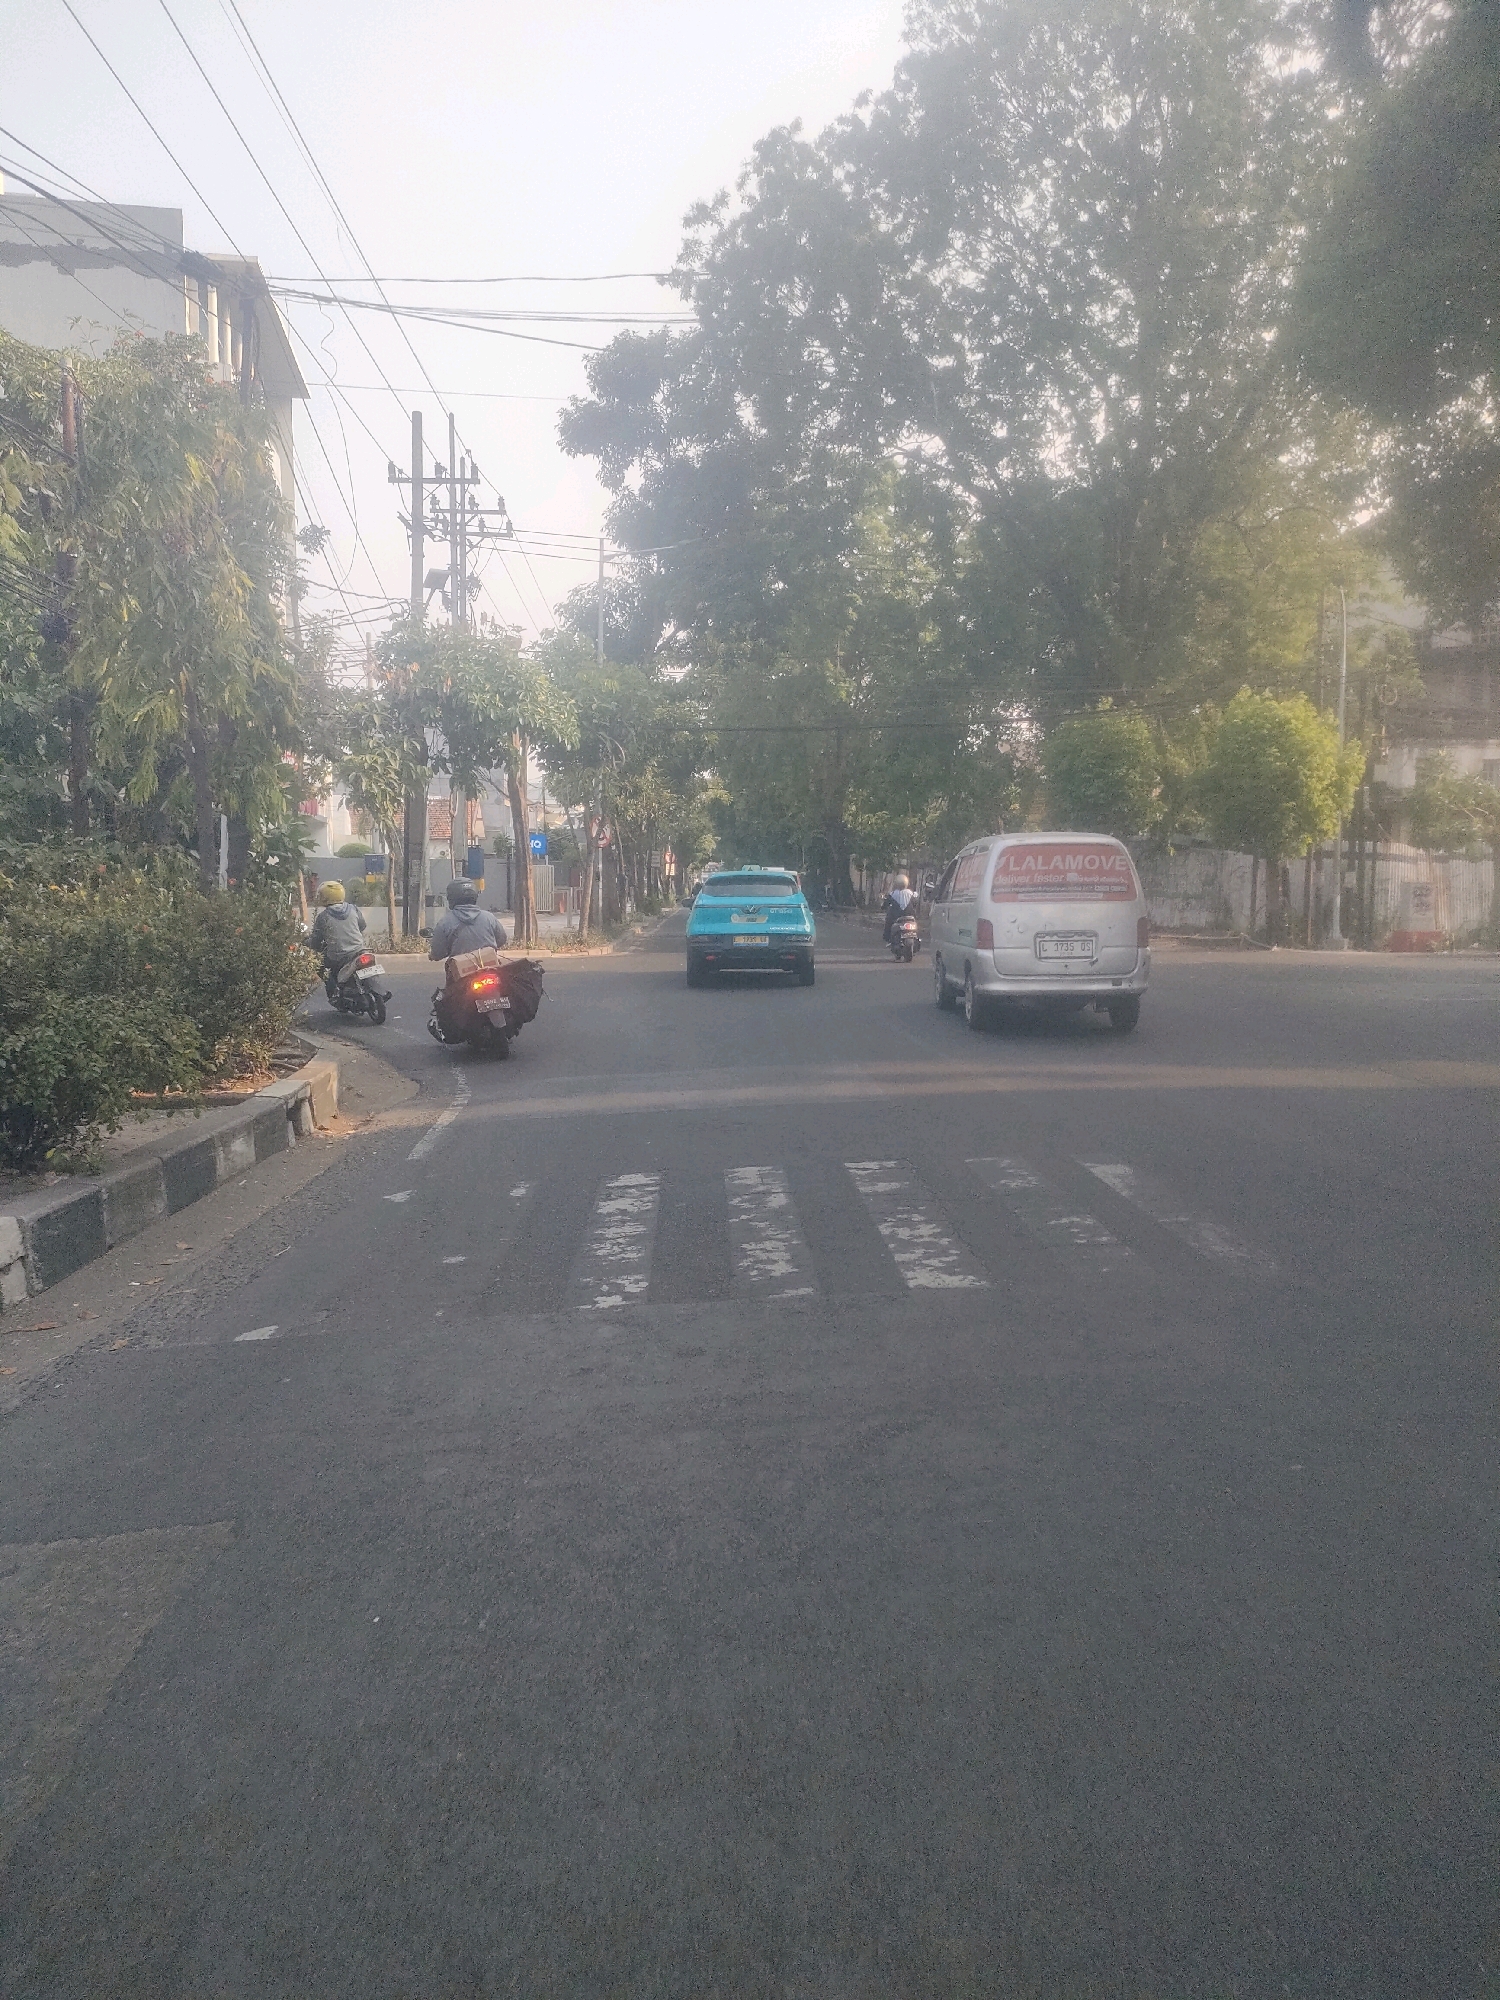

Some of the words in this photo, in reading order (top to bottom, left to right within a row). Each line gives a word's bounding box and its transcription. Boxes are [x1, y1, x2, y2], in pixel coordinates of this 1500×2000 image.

[1009, 854, 1128, 871] LALAMOVE
[994, 874, 1031, 885] deliver
[1041, 943, 1048, 952] L
[1054, 942, 1075, 952] 1735
